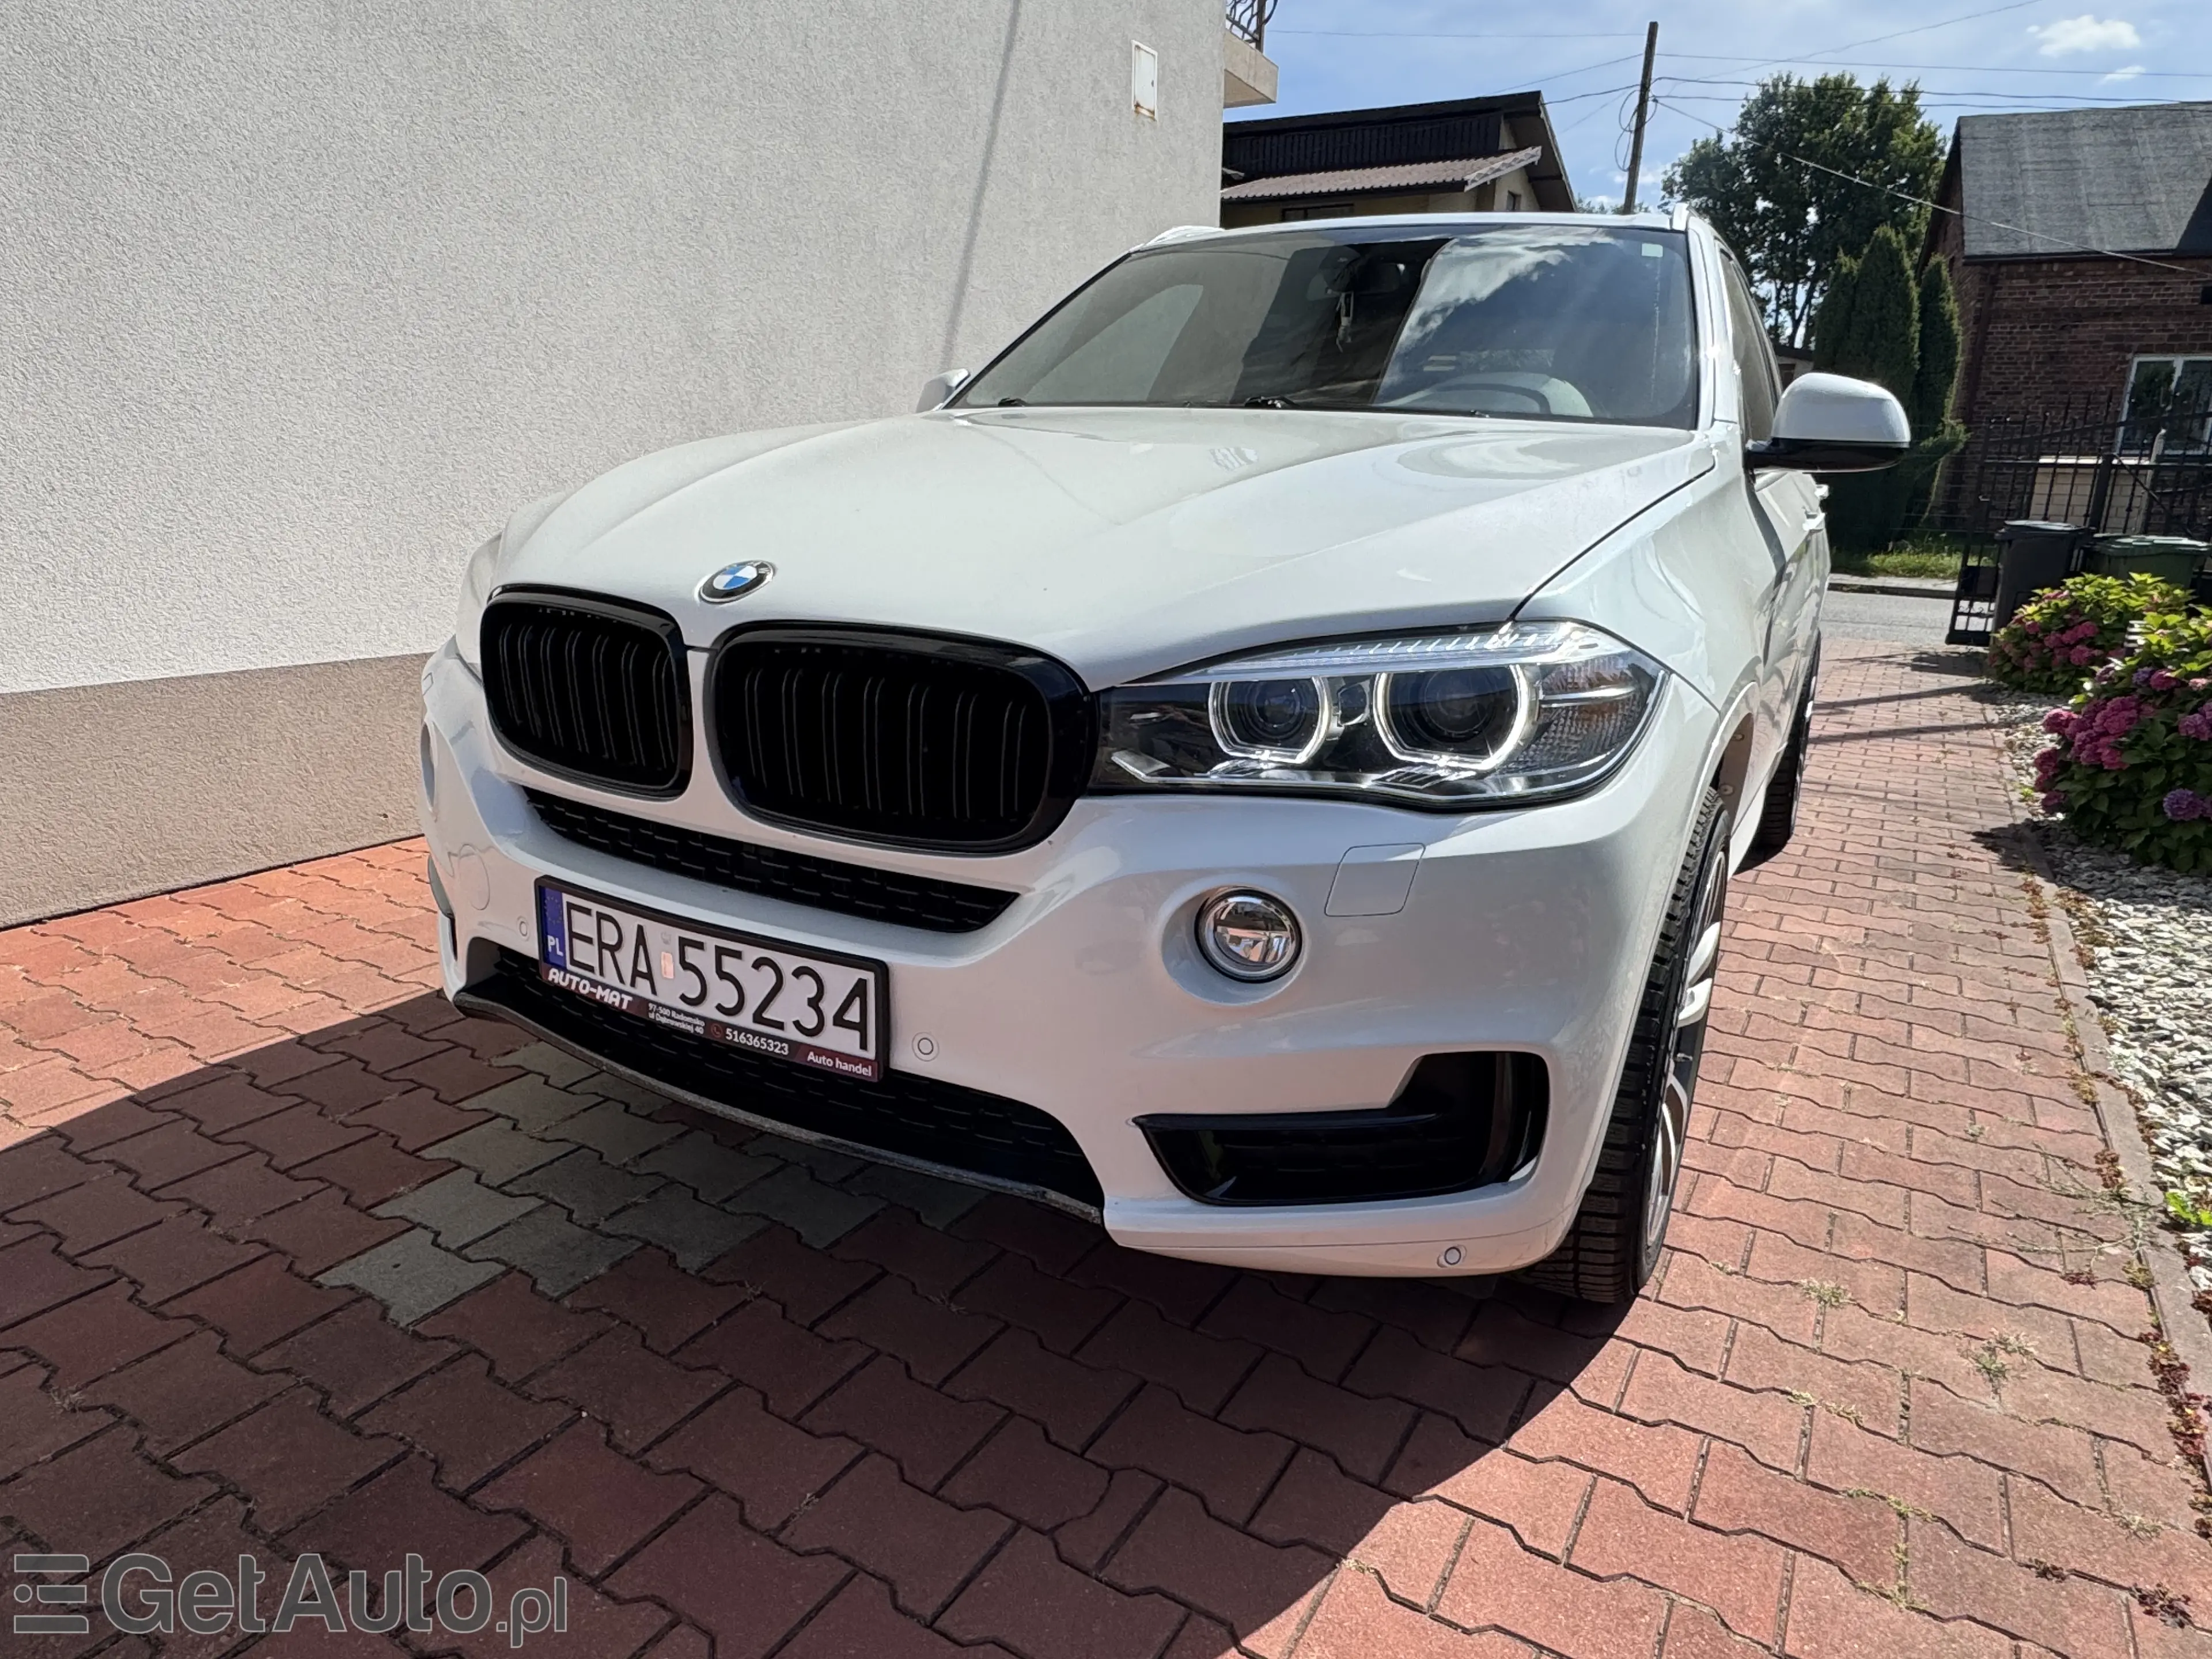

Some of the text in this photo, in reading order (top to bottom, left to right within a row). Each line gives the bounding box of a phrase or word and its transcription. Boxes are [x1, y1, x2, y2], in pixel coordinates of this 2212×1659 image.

[547, 934, 564, 956] PL
[548, 967, 633, 1010] AUTO-MAT
[566, 901, 869, 1051] ERA 55234
[671, 1010, 706, 1027] Radomsko
[725, 1028, 789, 1056] 516365323
[807, 1051, 872, 1077] Auto handel
